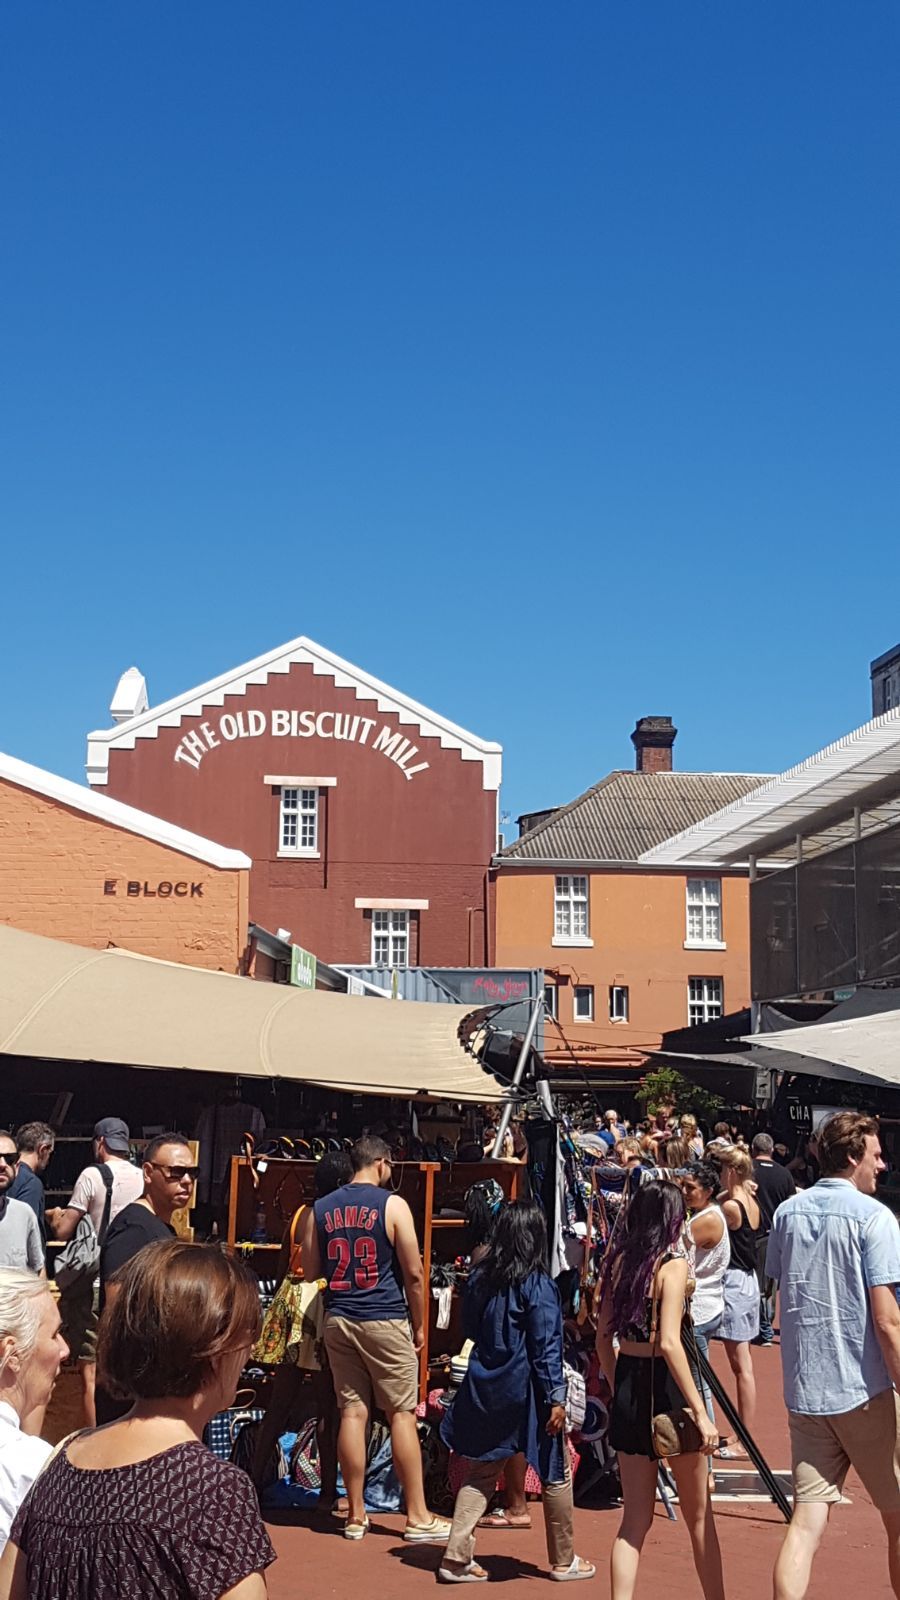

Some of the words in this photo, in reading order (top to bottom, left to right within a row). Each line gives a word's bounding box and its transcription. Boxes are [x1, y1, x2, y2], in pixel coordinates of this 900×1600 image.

[174, 721, 221, 769] THE
[220, 710, 267, 741] OLD
[271, 709, 376, 744] BISCUIT
[372, 726, 430, 781] MILL
[104, 880, 117, 896] E
[127, 881, 204, 898] BLOCK
[325, 1206, 379, 1233] JAMES
[328, 1236, 379, 1290] 23
